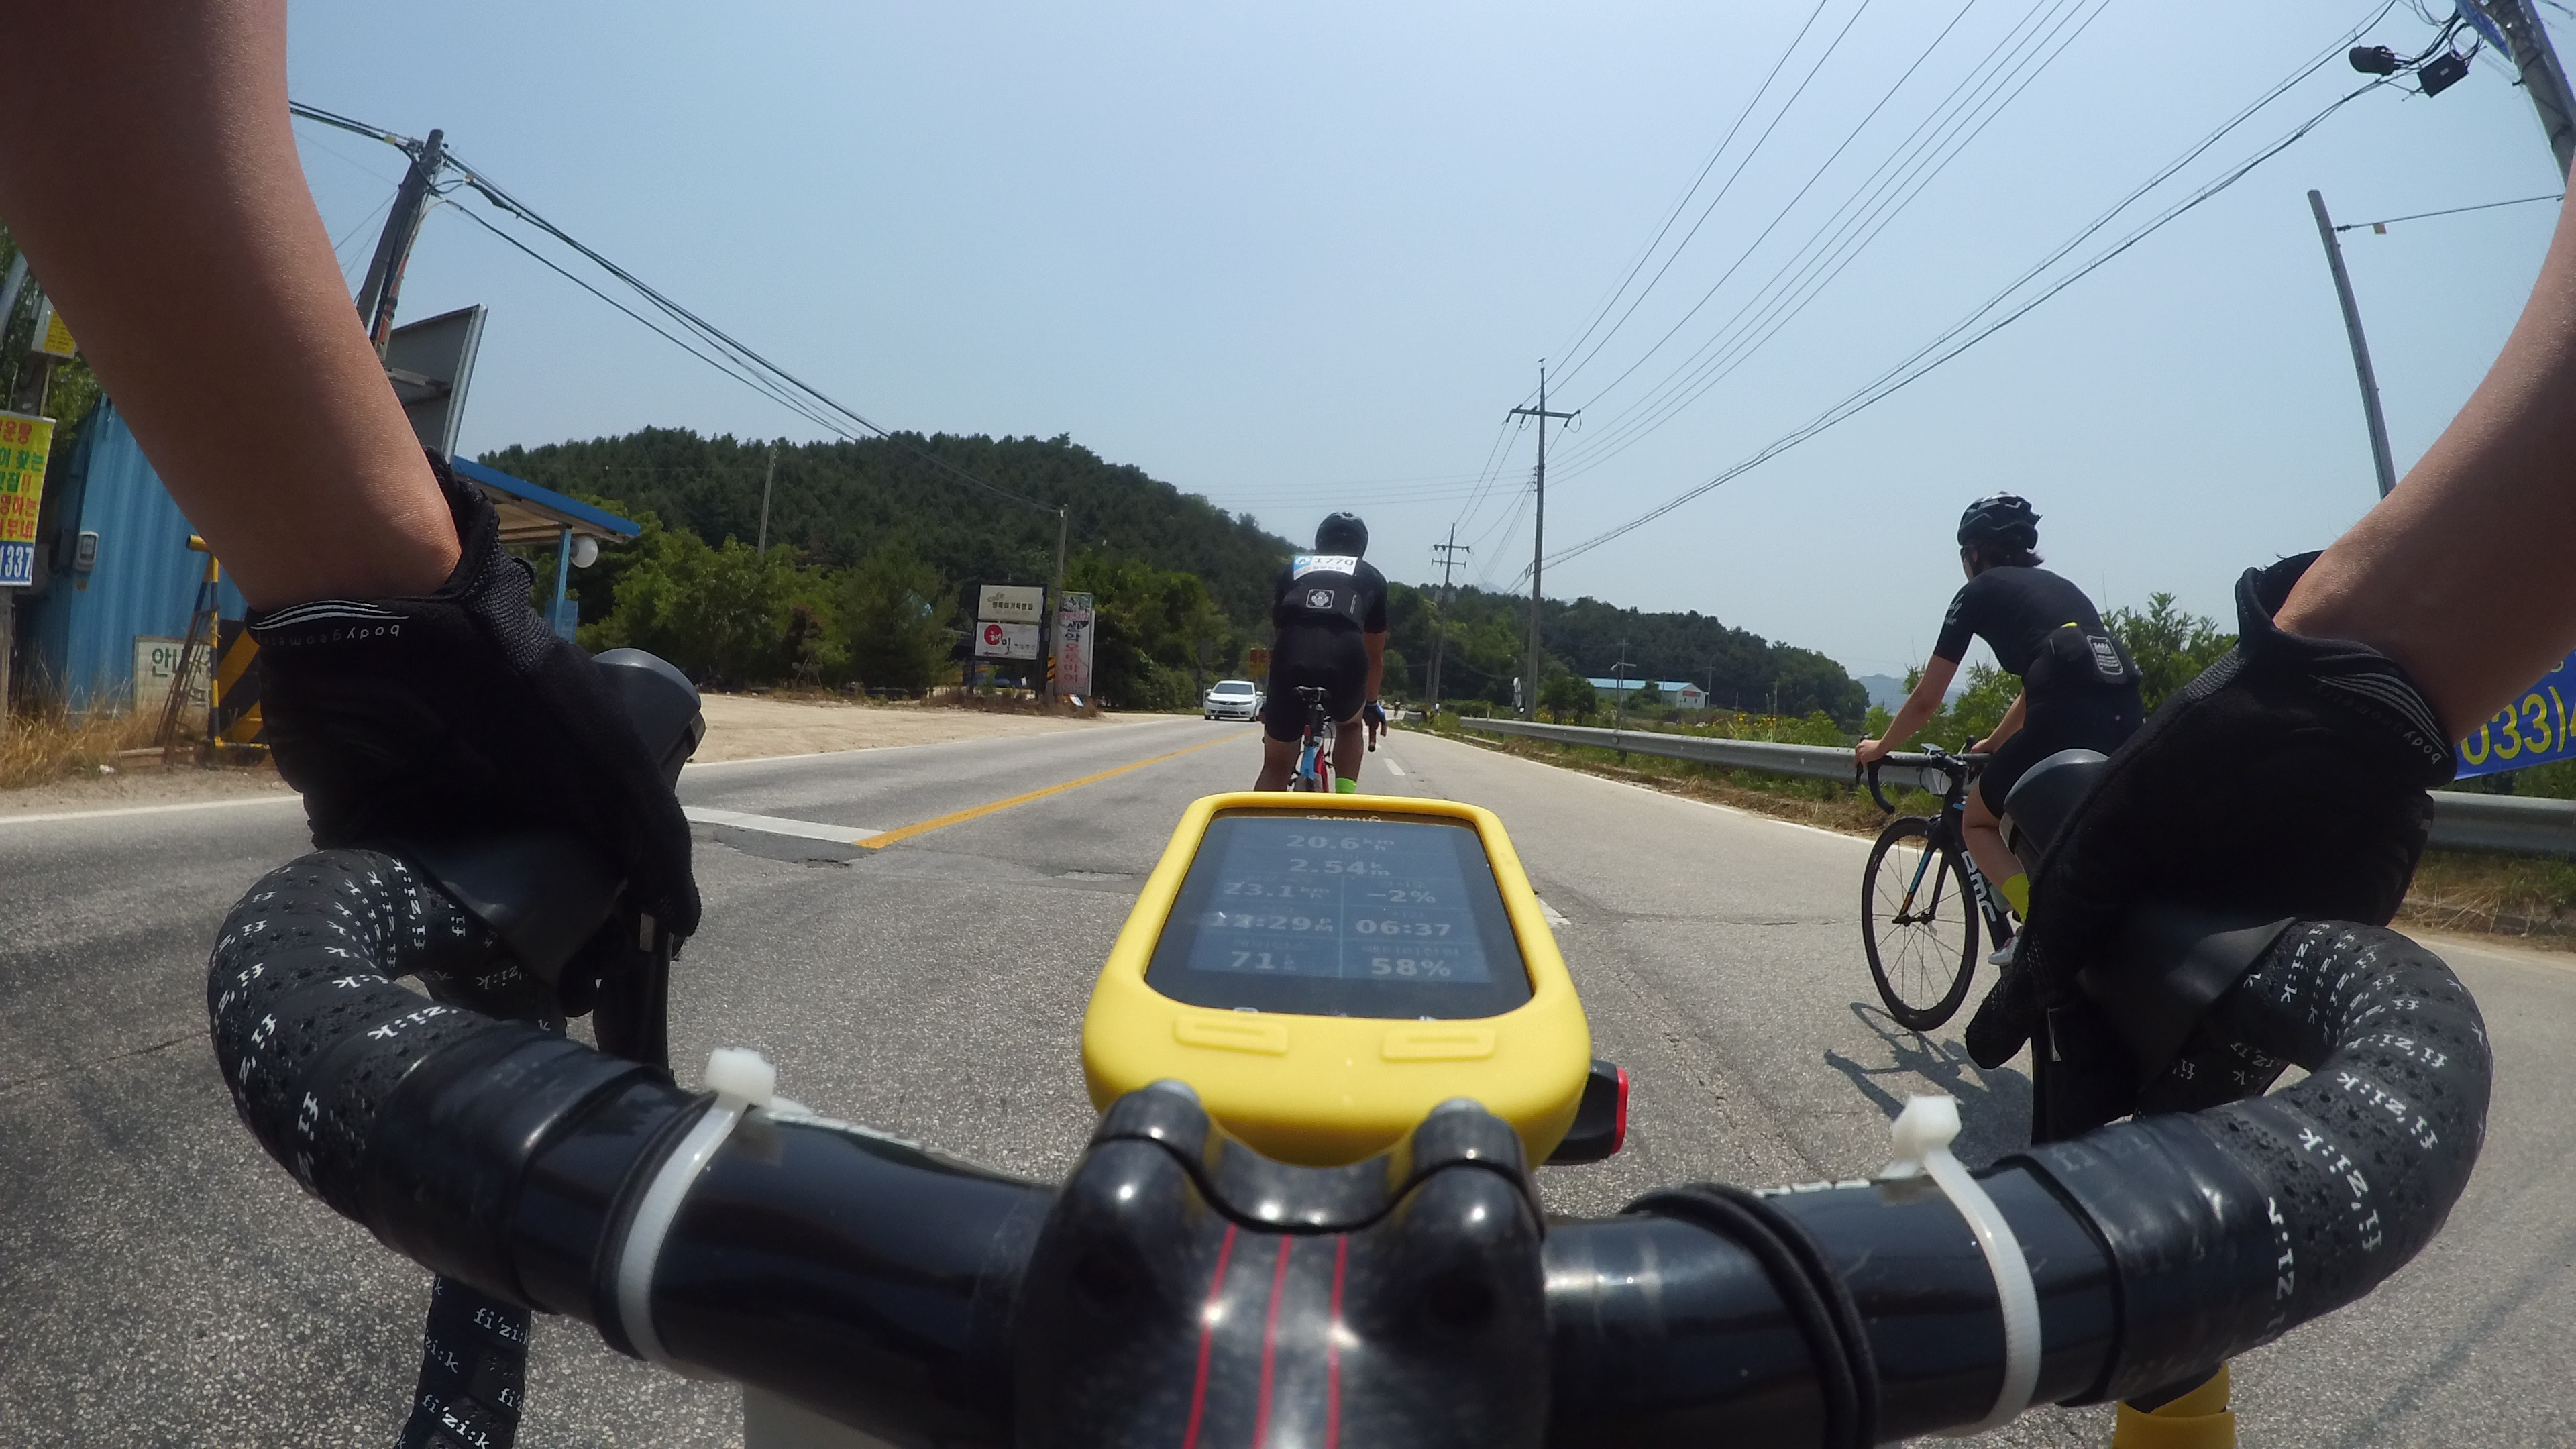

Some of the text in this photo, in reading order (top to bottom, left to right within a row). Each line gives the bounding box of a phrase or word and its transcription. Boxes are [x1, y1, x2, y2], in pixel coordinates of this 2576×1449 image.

[1316, 557, 1354, 566] 1770
[347, 625, 400, 639] body
[1286, 835, 1360, 849] 20.6
[1289, 859, 1368, 875] 2.54
[1223, 881, 1295, 898] 23.1
[1356, 919, 1451, 937] 06:37
[1232, 951, 1276, 970] 71
[1371, 957, 1452, 977] 58%
